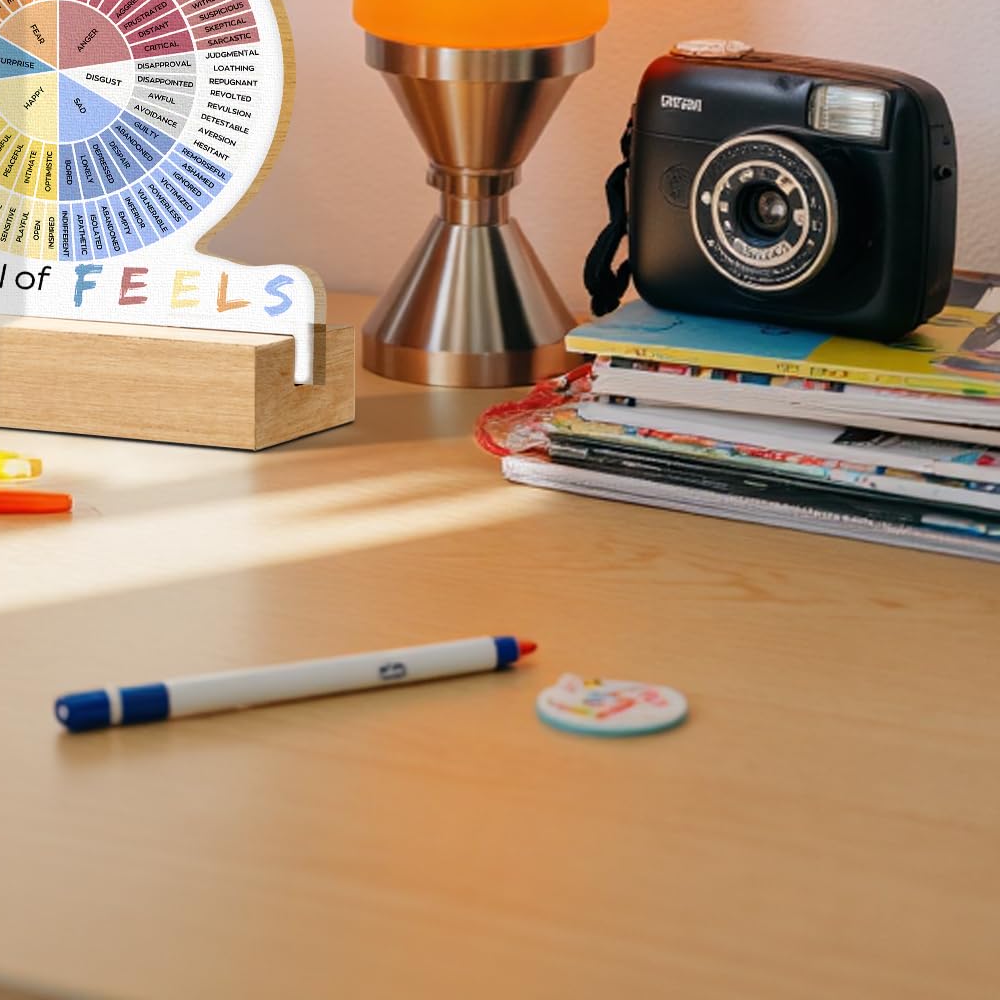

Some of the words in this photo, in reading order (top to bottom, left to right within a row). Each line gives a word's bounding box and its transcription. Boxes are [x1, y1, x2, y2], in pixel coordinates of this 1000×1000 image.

[124, 1, 168, 30] FRUSTRATED
[199, 1, 244, 20] SUSPICIOUS
[30, 24, 45, 45] FEAR
[138, 21, 169, 38] DISTANT
[205, 18, 247, 32] SKEPTICAL
[77, 28, 99, 52] ANGER
[145, 42, 179, 51] CRITICAL
[208, 33, 251, 46] SARCASTIC
[138, 60, 192, 69] DISAPPROVAL
[206, 50, 259, 59] JUDGMENTAL
[86, 73, 122, 87] DISGUST
[137, 76, 193, 87] DISAPPOINTED
[209, 78, 258, 86] REPUGNANT
[24, 87, 45, 109] HAPPY
[73, 98, 86, 114] SAD
[148, 92, 175, 104] AWFUL
[210, 90, 251, 102] REVOLTED
[134, 105, 177, 128] AVOIDANCE
[208, 102, 251, 118] REVULSION
[134, 122, 159, 139] GUILTY
[201, 113, 249, 134] DETESTABLE
[115, 126, 153, 162] ABANDONED
[198, 127, 236, 146] AVERSION
[3, 144, 24, 177] PEACEFUL
[109, 141, 131, 169] DESPAIR
[194, 140, 229, 161] HESITANT
[24, 150, 37, 184] INTIMATE
[45, 151, 53, 191] OPTIMISTIC
[65, 160, 73, 185] BORED
[80, 155, 94, 183] LONELY
[93, 144, 114, 184] DEPRESSED
[182, 148, 226, 180] REMORSEFUL
[182, 163, 214, 189] ASHAMED
[160, 177, 192, 211] VICTIMIZED
[172, 171, 201, 196] IGNORED
[125, 197, 145, 228] INFERIOR
[137, 189, 167, 232] VULNERABLE
[149, 184, 181, 222] POWERLESS
[1, 208, 16, 242] SENSITIVE
[16, 212, 29, 242] PLAYFUL
[77, 215, 87, 255] APATHETIC
[90, 215, 102, 250] ISOLATED
[101, 206, 120, 251] ABANDONED
[118, 211, 131, 235] EMPTY
[15, 266, 51, 290] of
